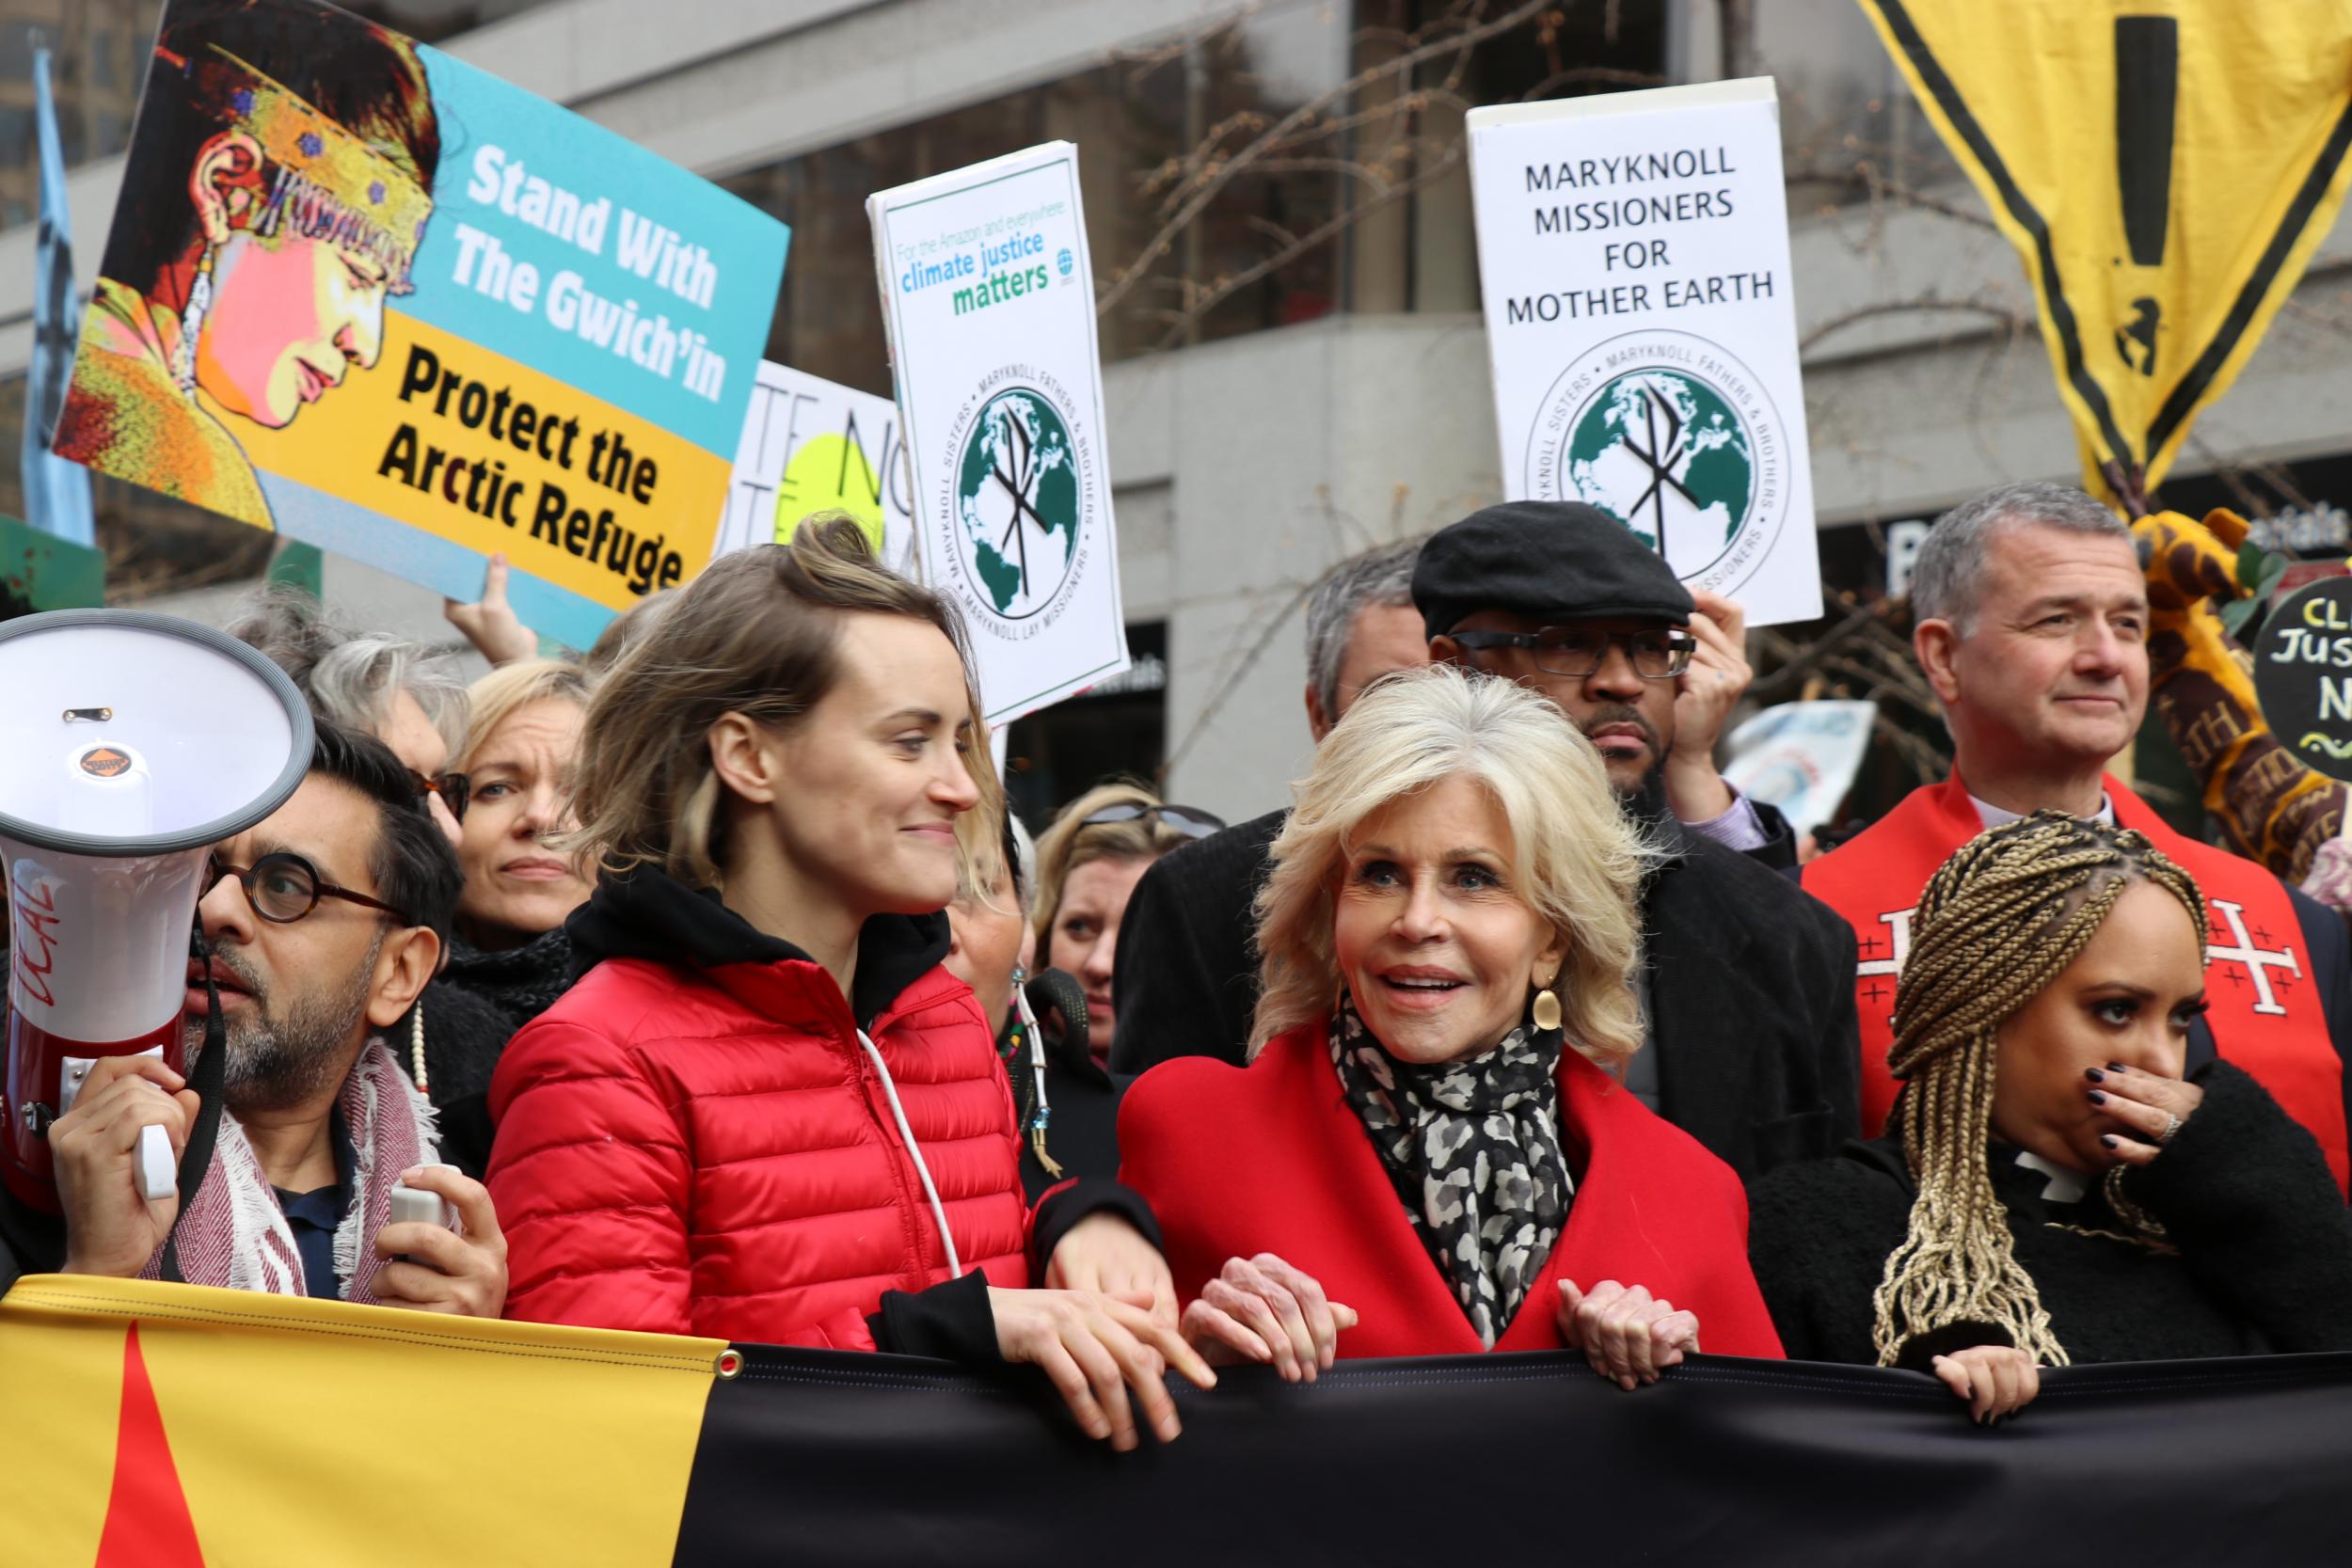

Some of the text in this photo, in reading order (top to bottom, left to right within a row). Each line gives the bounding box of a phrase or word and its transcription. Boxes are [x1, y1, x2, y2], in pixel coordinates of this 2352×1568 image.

[1525, 146, 1736, 193] MARYKNOLL
[468, 144, 719, 310] Stand With
[897, 243, 916, 261] For
[919, 237, 937, 255] the
[940, 226, 982, 248] Amazon
[985, 216, 1003, 236] and
[1534, 188, 1733, 235] MISSIONERS
[901, 231, 1044, 293] climate justice
[1605, 239, 1671, 272] FOR
[452, 223, 727, 404] The Gwich'in
[952, 263, 1049, 316] matters
[1506, 270, 1774, 325] MOTHER EARTH
[398, 342, 658, 505] Protect the
[1549, 372, 1592, 431] SISTERS
[1606, 344, 1777, 510] MARYKNOLL FATHERS & BROTHERS
[978, 363, 1093, 524] MARYKNOLL FATHERS & BROTHERS
[377, 422, 684, 596] Arctic Refuge
[940, 403, 971, 578] MARYKNOLL SISTERS
[964, 548, 1088, 641] MARYKNOLL LAY MISSIONERS
[2303, 596, 2352, 630] CL
